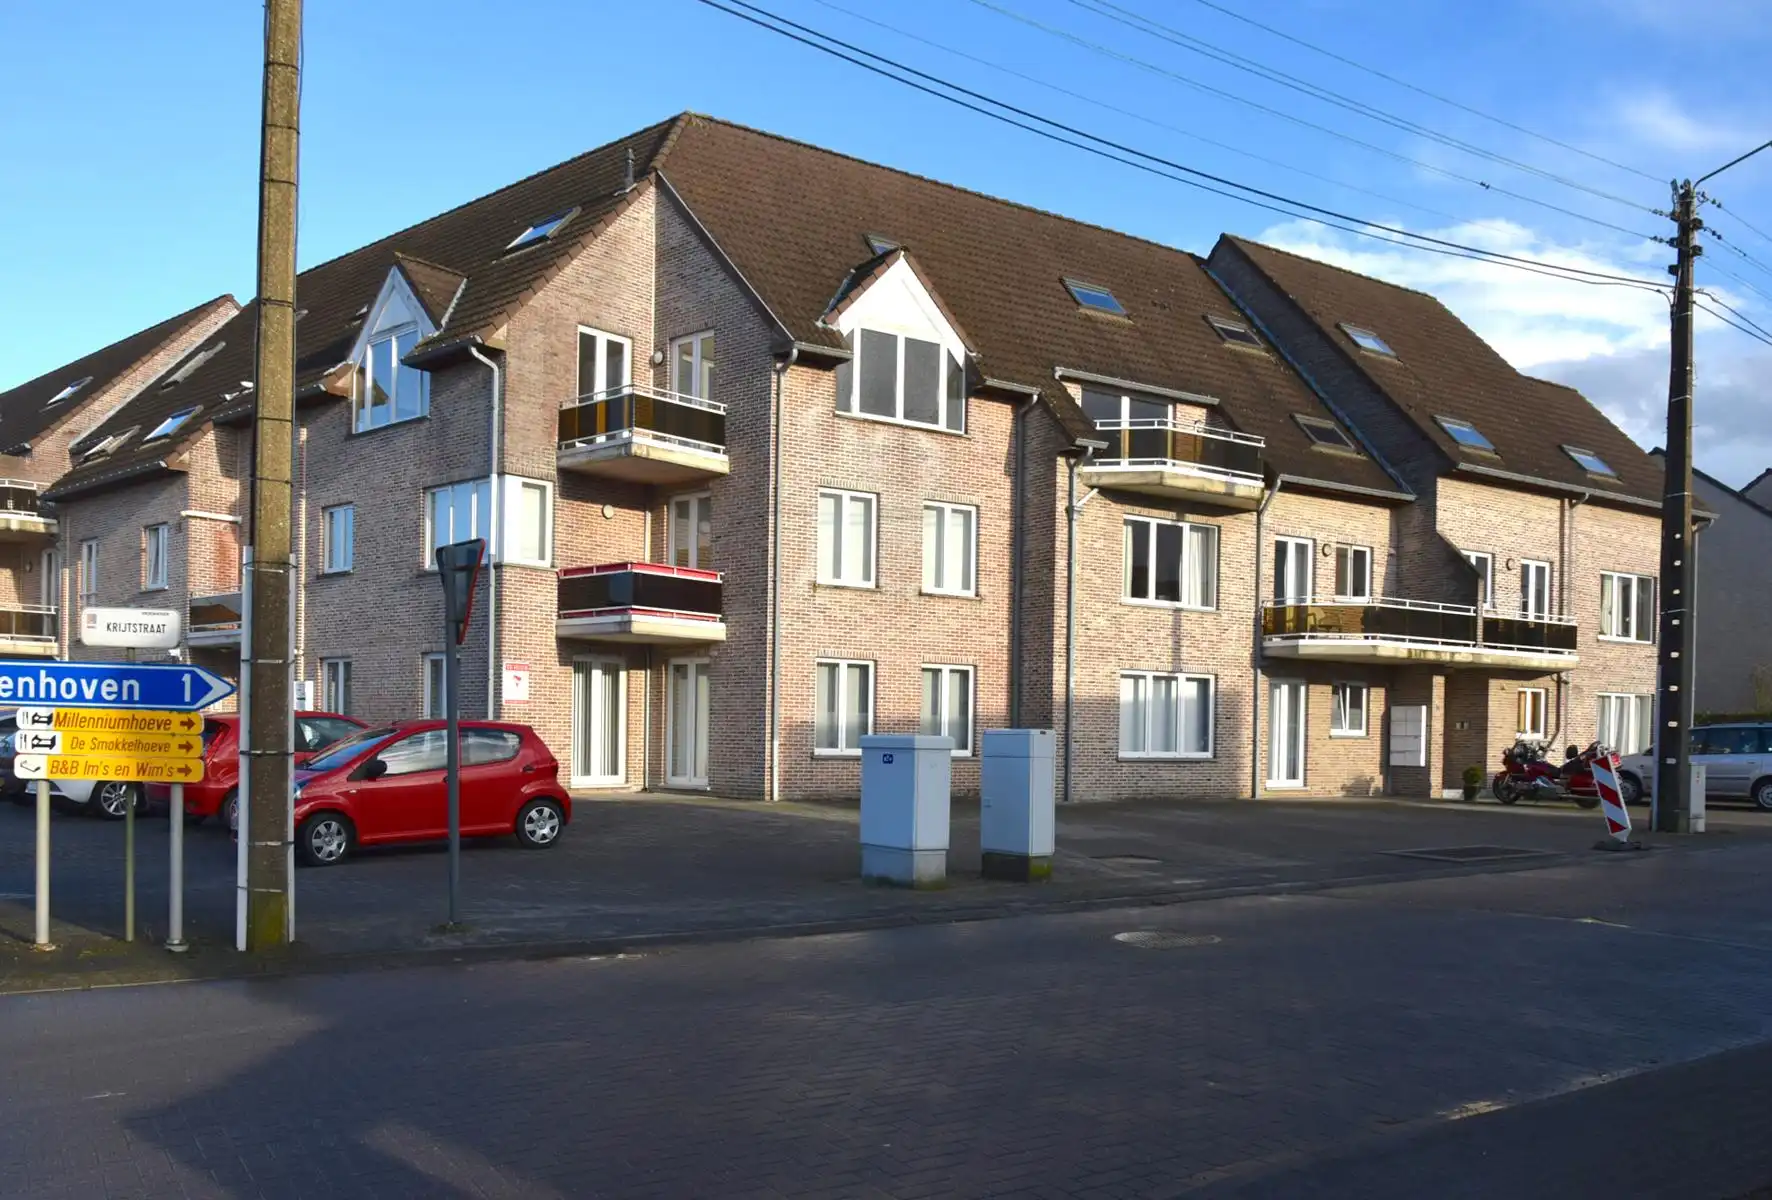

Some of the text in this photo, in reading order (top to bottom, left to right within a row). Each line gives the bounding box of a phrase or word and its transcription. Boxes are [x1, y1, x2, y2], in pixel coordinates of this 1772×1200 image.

[106, 622, 167, 633] KRIJTSTRAAT
[181, 673, 192, 702] 1
[54, 711, 172, 731] Millenniumhoeve
[70, 736, 170, 753] De Smokkelhoeve
[50, 759, 79, 775] B&B
[114, 766, 131, 776] en
[136, 760, 176, 777] Wim's
